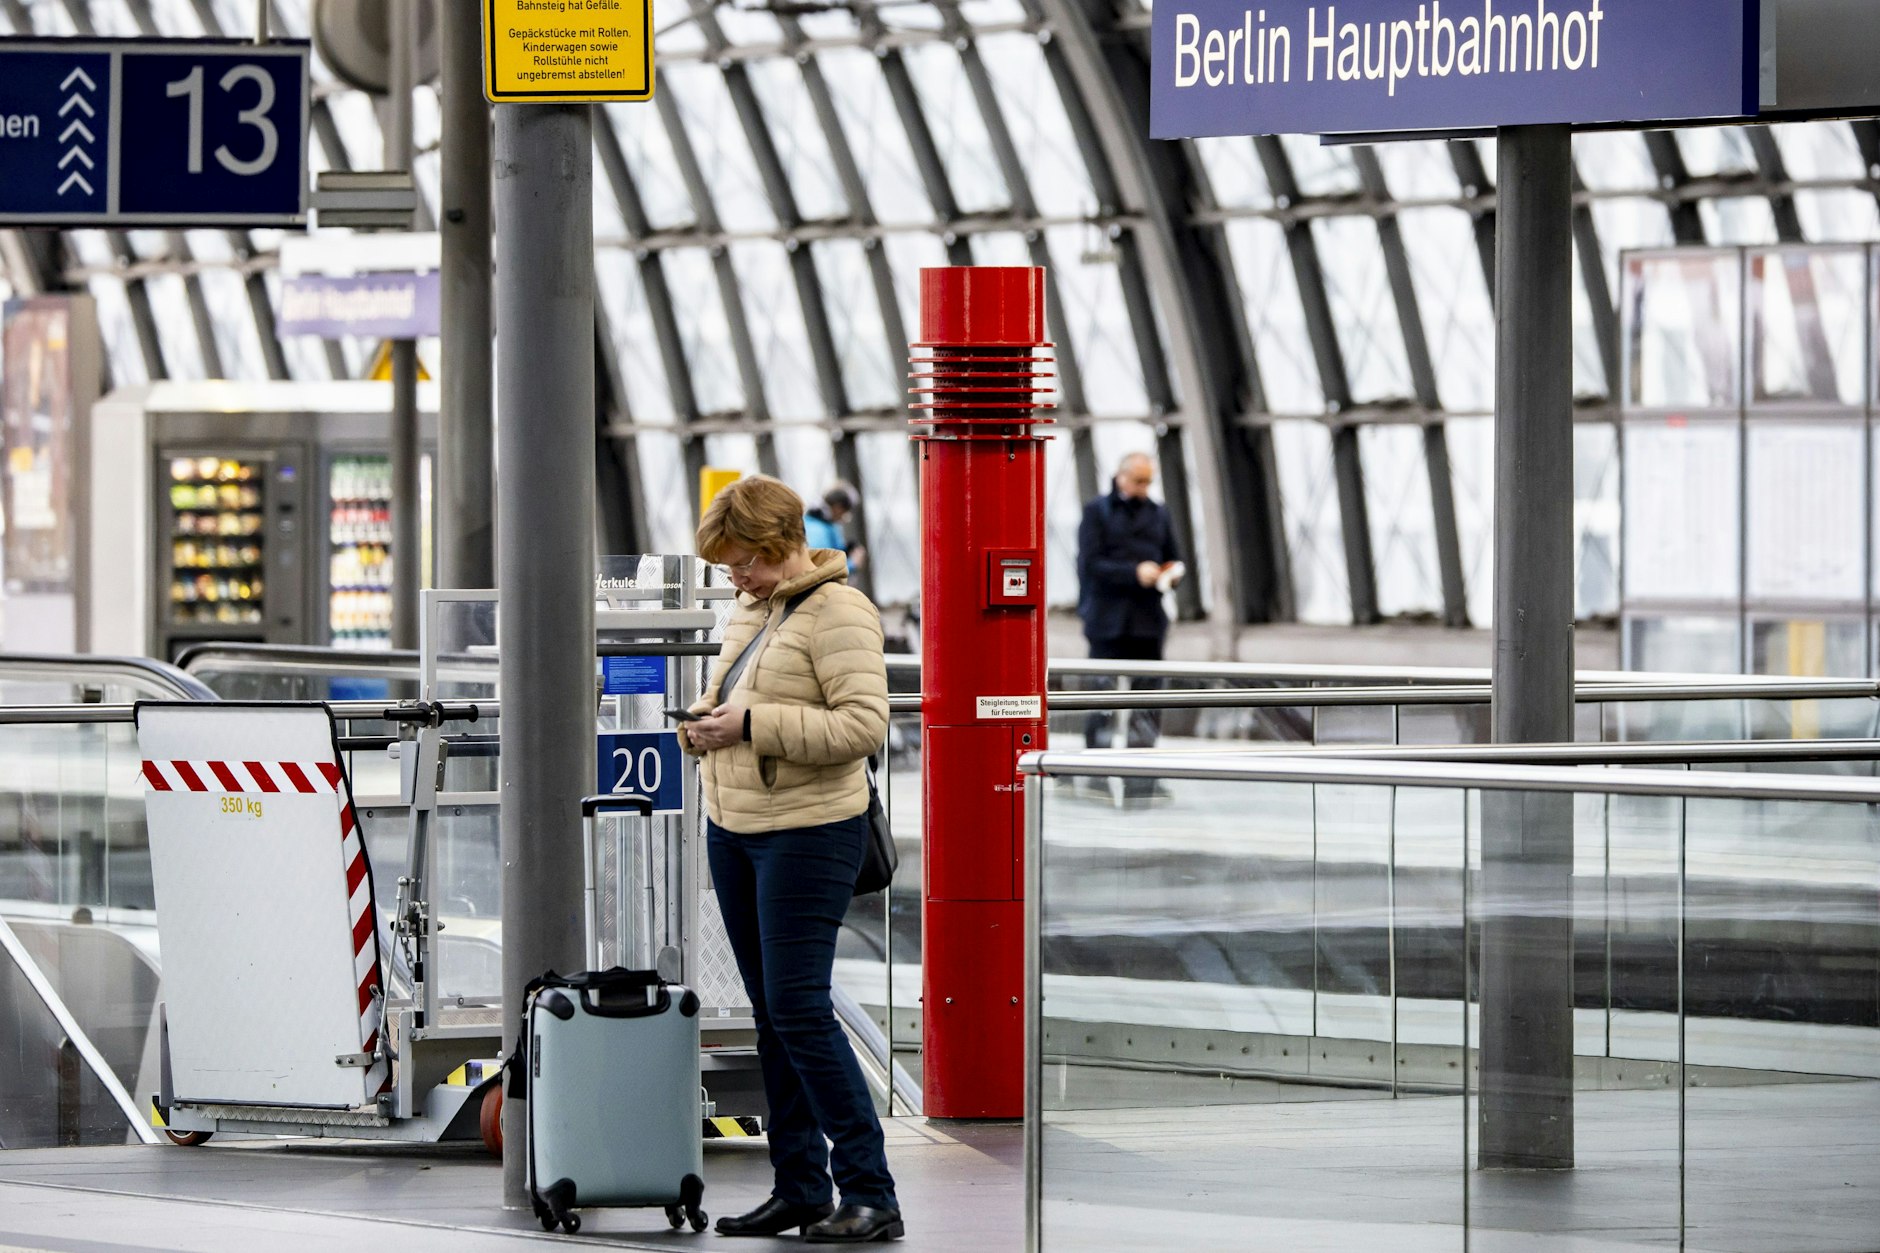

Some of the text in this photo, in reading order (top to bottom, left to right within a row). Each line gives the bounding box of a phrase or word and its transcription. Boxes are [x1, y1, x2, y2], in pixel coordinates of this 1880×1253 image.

[517, 0, 622, 12] Bahnsteig hat Gefälle.
[508, 28, 577, 40] Gepäckstücke
[579, 28, 596, 38] mit
[523, 41, 618, 54] Kinderwagen sowie
[1175, 0, 1604, 97] Berlin Hauptbahnhof
[533, 55, 609, 66] Rollstühle nicht
[516, 68, 625, 83] ungebremst abstellen!
[166, 64, 279, 176] 13
[1001, 708, 1032, 716] Feuerwehr
[612, 746, 661, 793] 20
[221, 796, 262, 818] 350 kg
